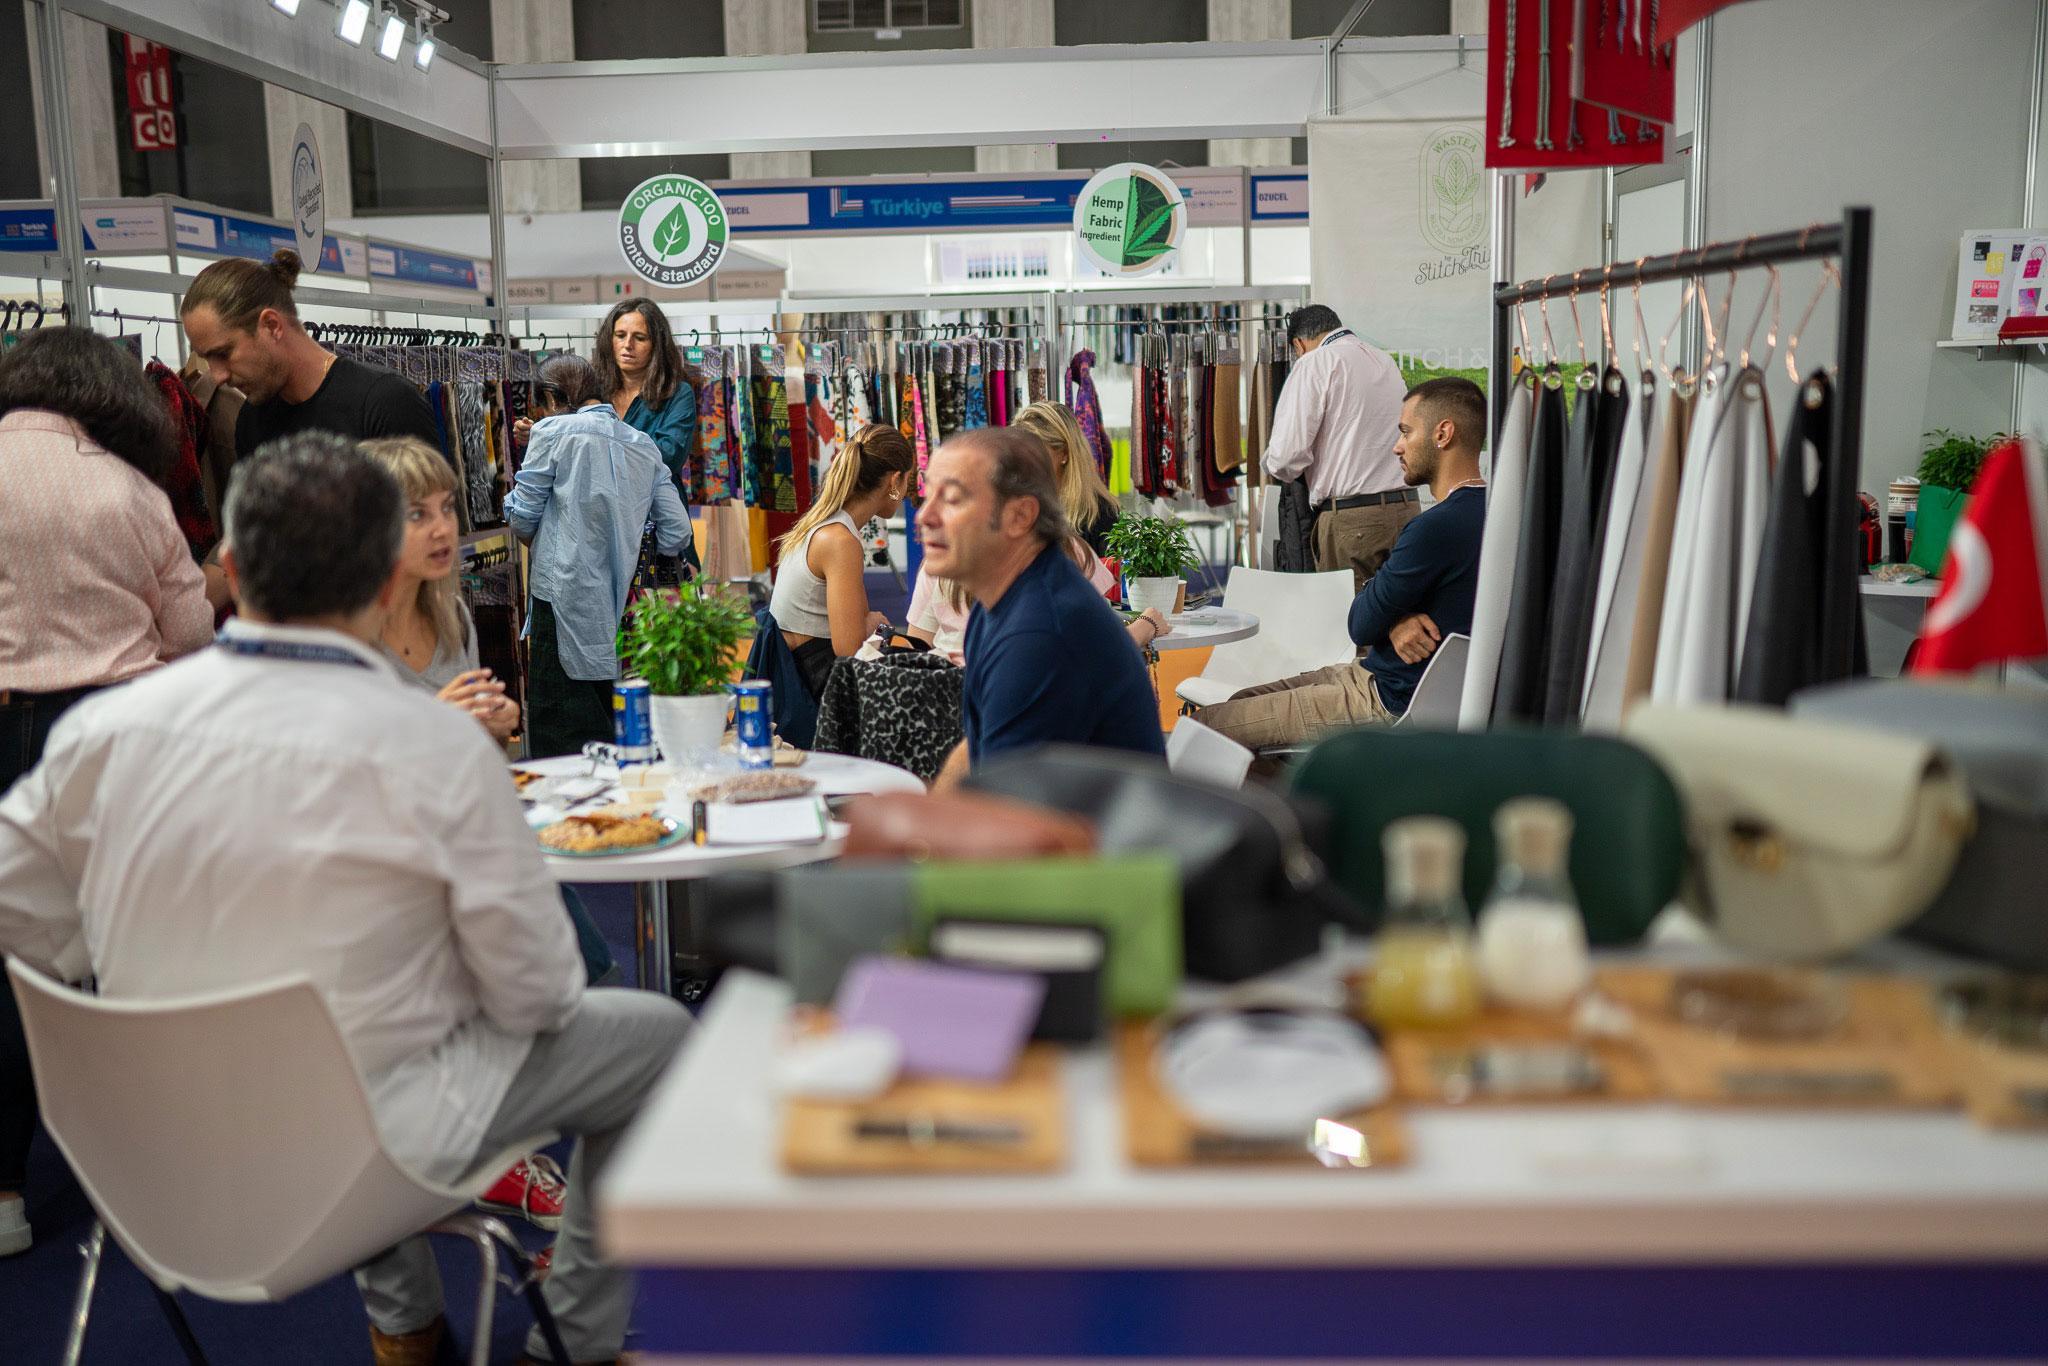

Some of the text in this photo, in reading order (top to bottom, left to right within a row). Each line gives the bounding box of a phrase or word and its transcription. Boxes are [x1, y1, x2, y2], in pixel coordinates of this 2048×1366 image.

[1432, 135, 1478, 155] WASTEA
[633, 182, 721, 226] ORGANIC 100
[870, 198, 945, 219] Türkiye
[1092, 195, 1124, 213] Hemp
[1089, 214, 1123, 229] Fabric
[1080, 227, 1121, 242] Ingredient
[623, 225, 720, 282] content standard
